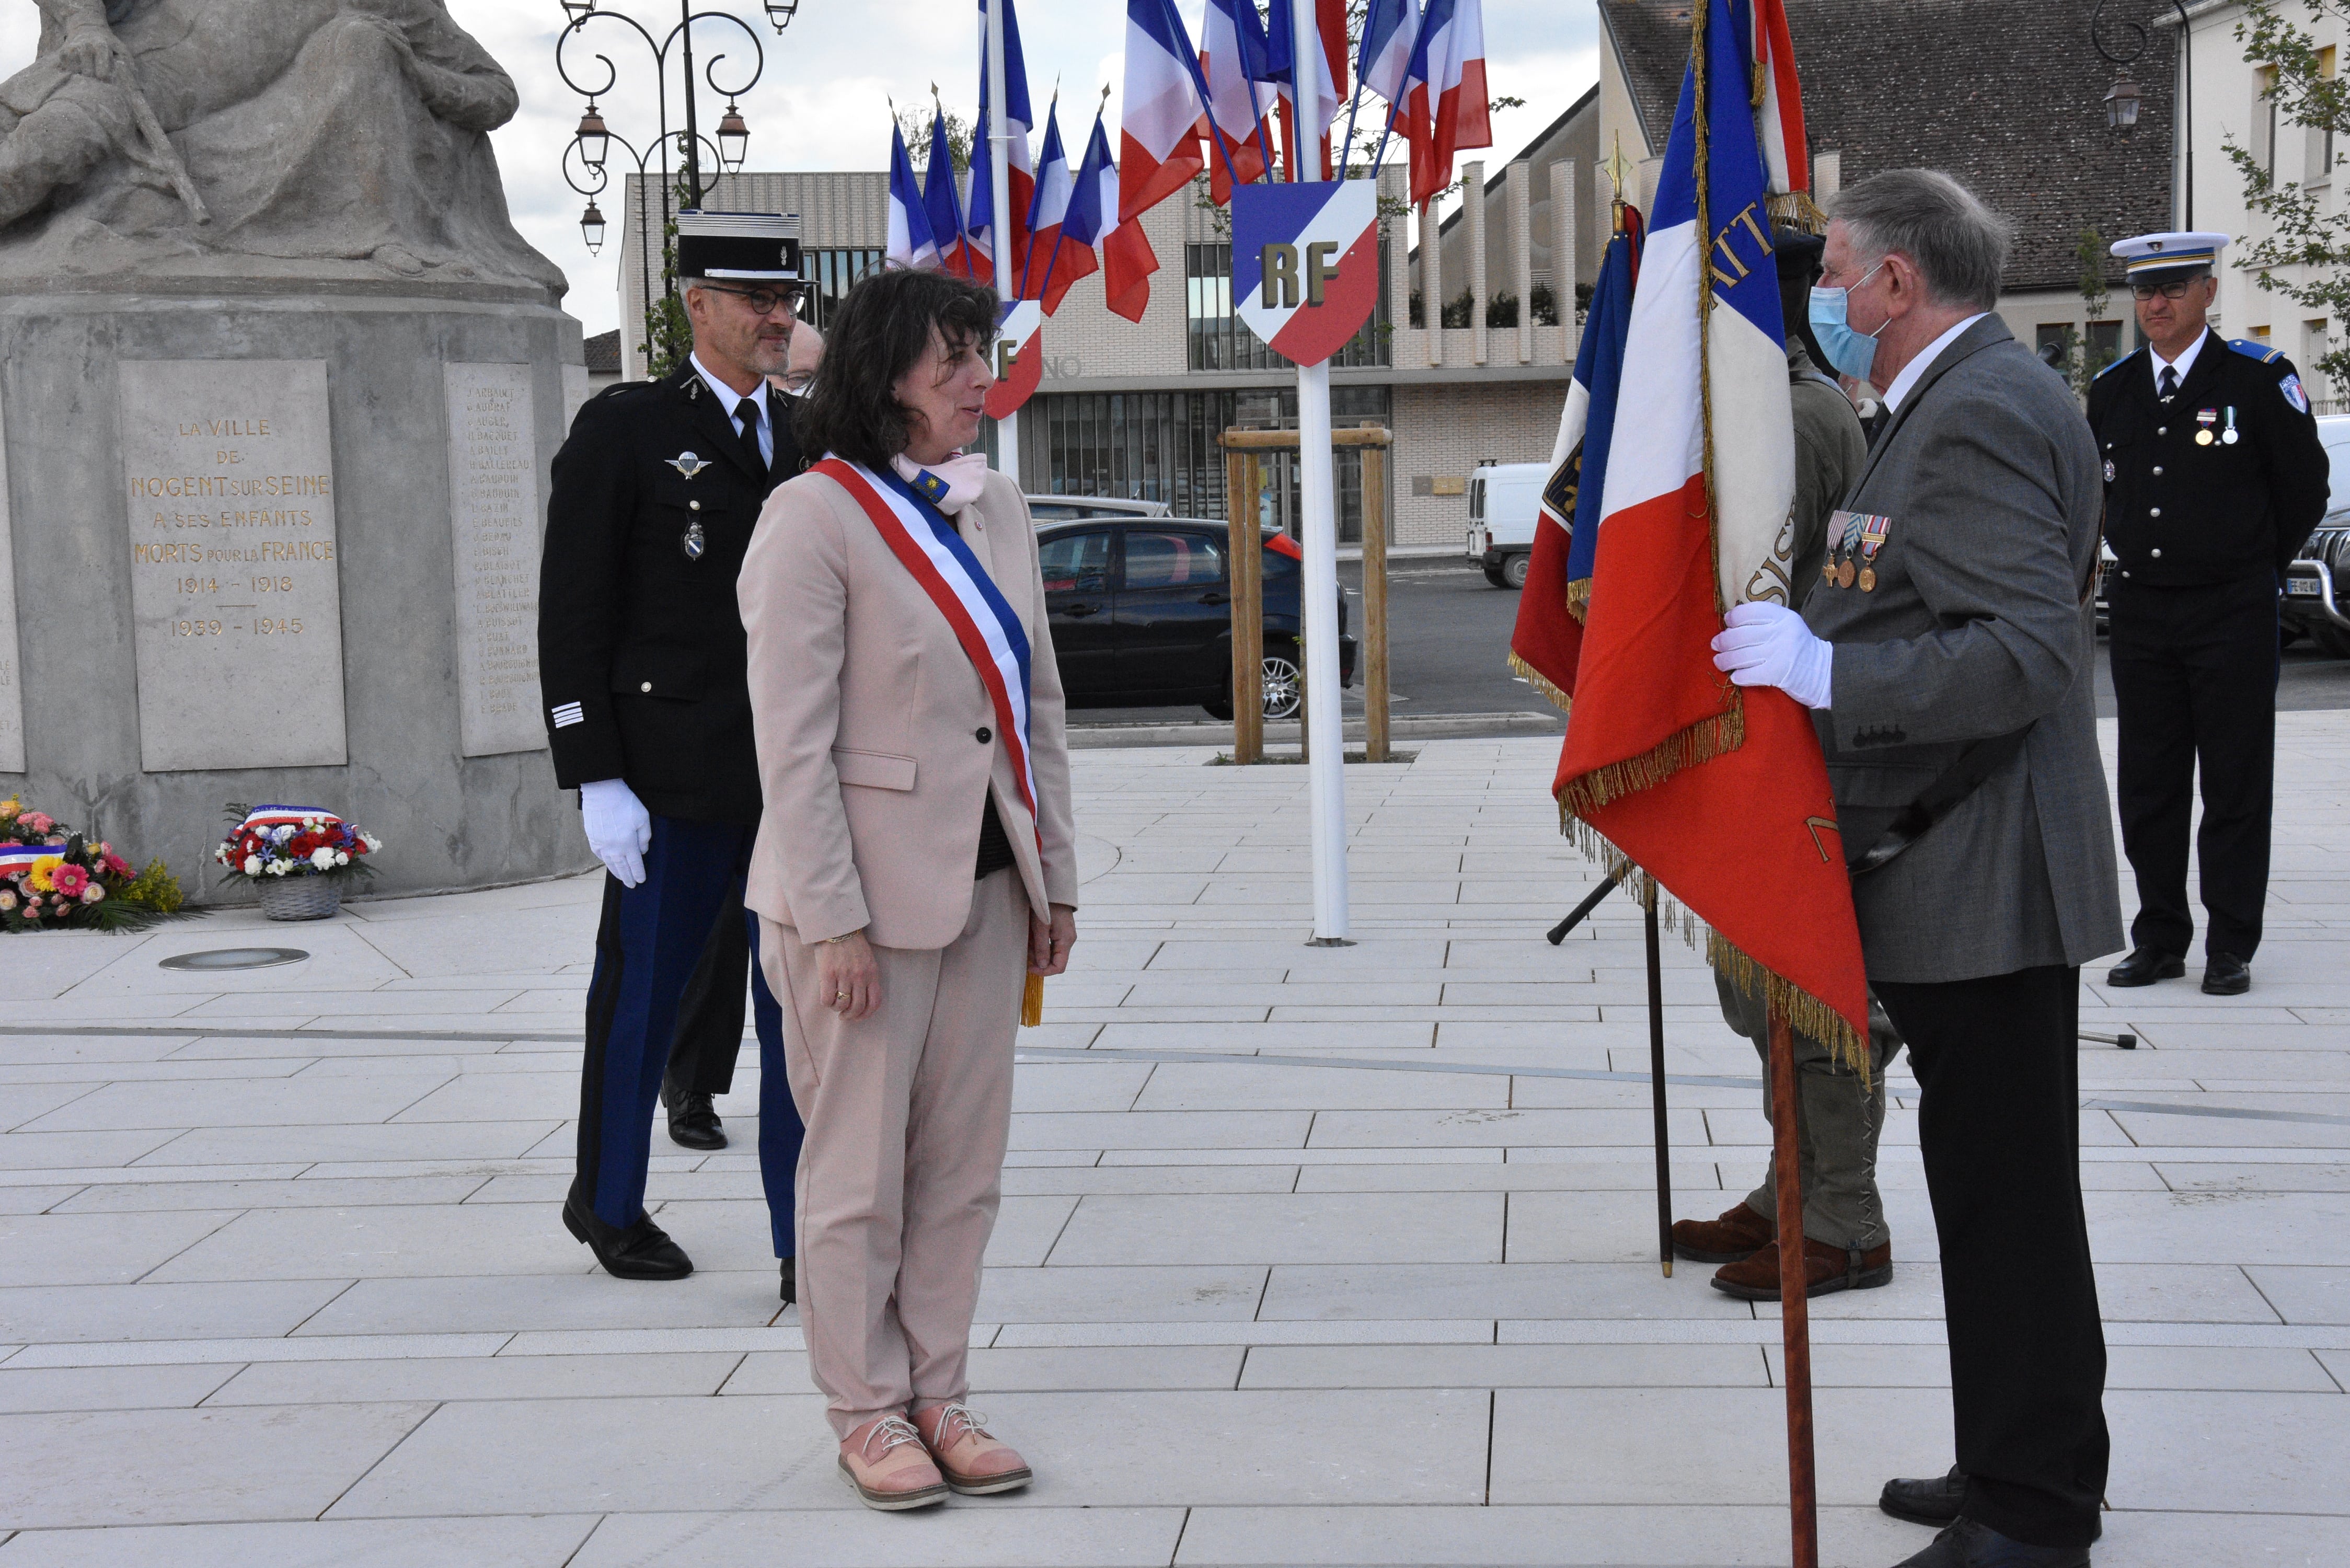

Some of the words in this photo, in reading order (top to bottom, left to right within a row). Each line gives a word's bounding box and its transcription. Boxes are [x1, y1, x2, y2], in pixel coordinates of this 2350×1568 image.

[1261, 241, 1340, 309] RF
[988, 340, 1017, 382] F
[180, 423, 201, 436] LA
[208, 420, 271, 436] VILLE
[478, 431, 518, 442] BACQUET
[217, 451, 239, 464] DE
[132, 477, 228, 497] NOGENT
[231, 481, 261, 495] SUR
[265, 476, 330, 495] SEINE
[154, 512, 166, 528] A
[176, 515, 210, 527] SES
[221, 510, 313, 527] ENFANTS
[134, 544, 203, 563] MORTS
[208, 550, 240, 562] POUR
[245, 549, 259, 562] LA
[262, 541, 333, 561] FRANCE
[178, 578, 218, 594] 1914
[252, 577, 293, 592] 1918
[171, 620, 222, 637] 1939
[254, 618, 304, 636] 1945
